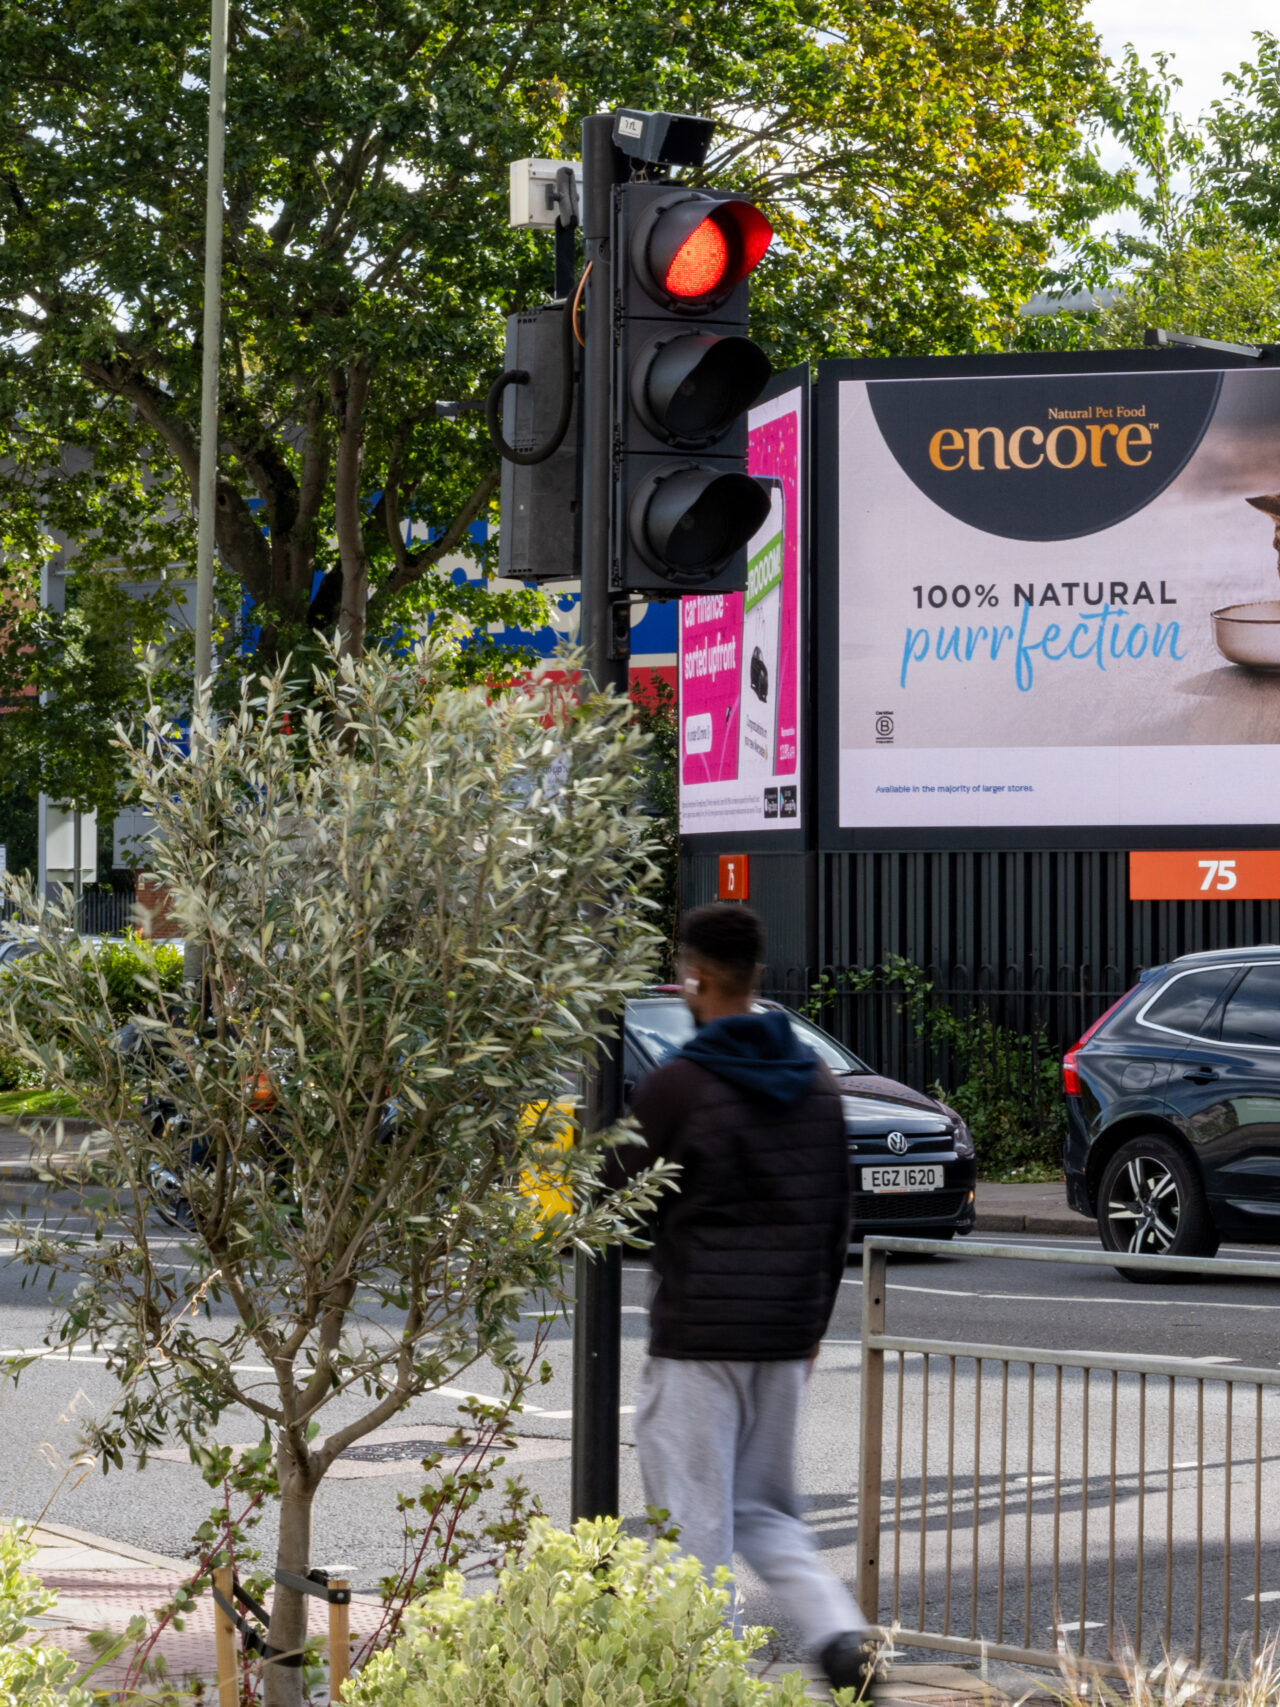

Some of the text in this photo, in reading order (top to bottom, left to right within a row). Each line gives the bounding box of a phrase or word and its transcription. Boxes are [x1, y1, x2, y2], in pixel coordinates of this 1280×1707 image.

[1048, 405, 1146, 420] Natural Pet Food
[912, 580, 1178, 609] 100% NATURAL
[684, 600, 697, 628] car
[684, 632, 736, 682] sorted upfront
[900, 600, 1189, 692] purrfection
[876, 784, 1034, 795] Available in the majority of larger stores.
[1198, 860, 1237, 891] 75
[871, 1168, 935, 1187] EGZ 1620
